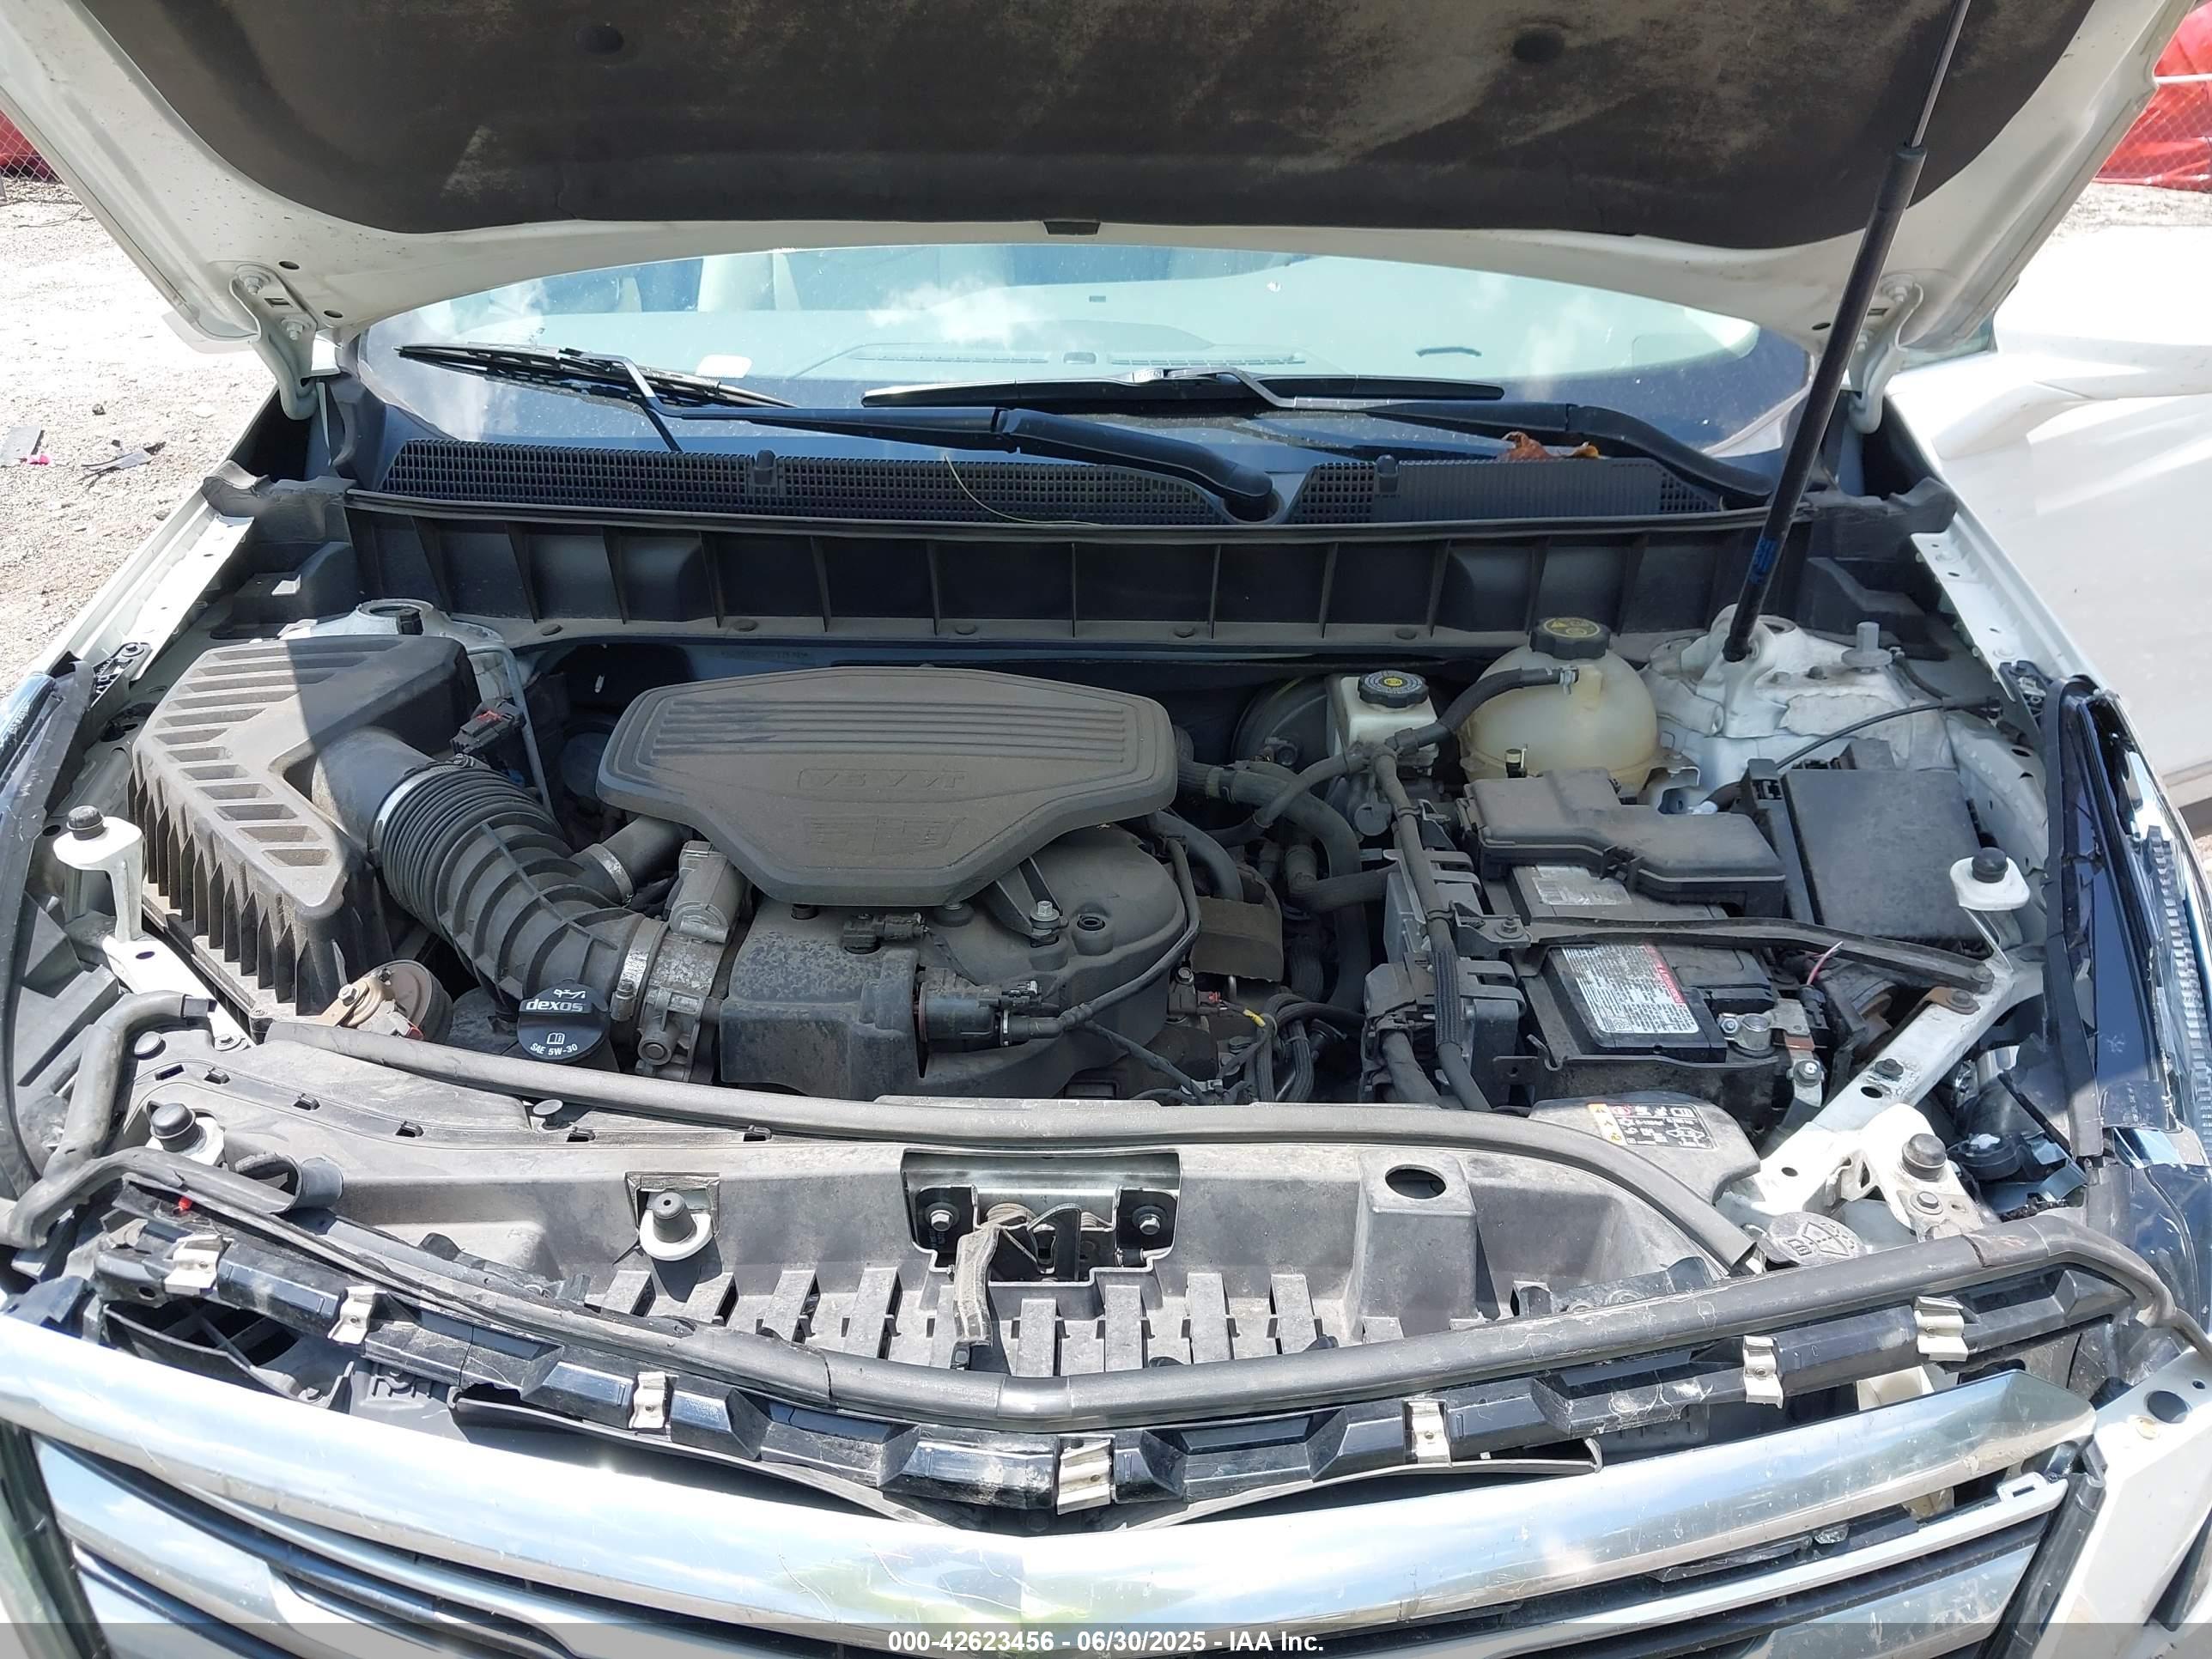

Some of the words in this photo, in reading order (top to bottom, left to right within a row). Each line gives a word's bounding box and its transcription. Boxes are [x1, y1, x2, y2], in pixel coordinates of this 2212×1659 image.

[526, 998, 584, 1012] dexos
[530, 1042, 545, 1054] SAE
[548, 1043, 578, 1055] 5W-30
